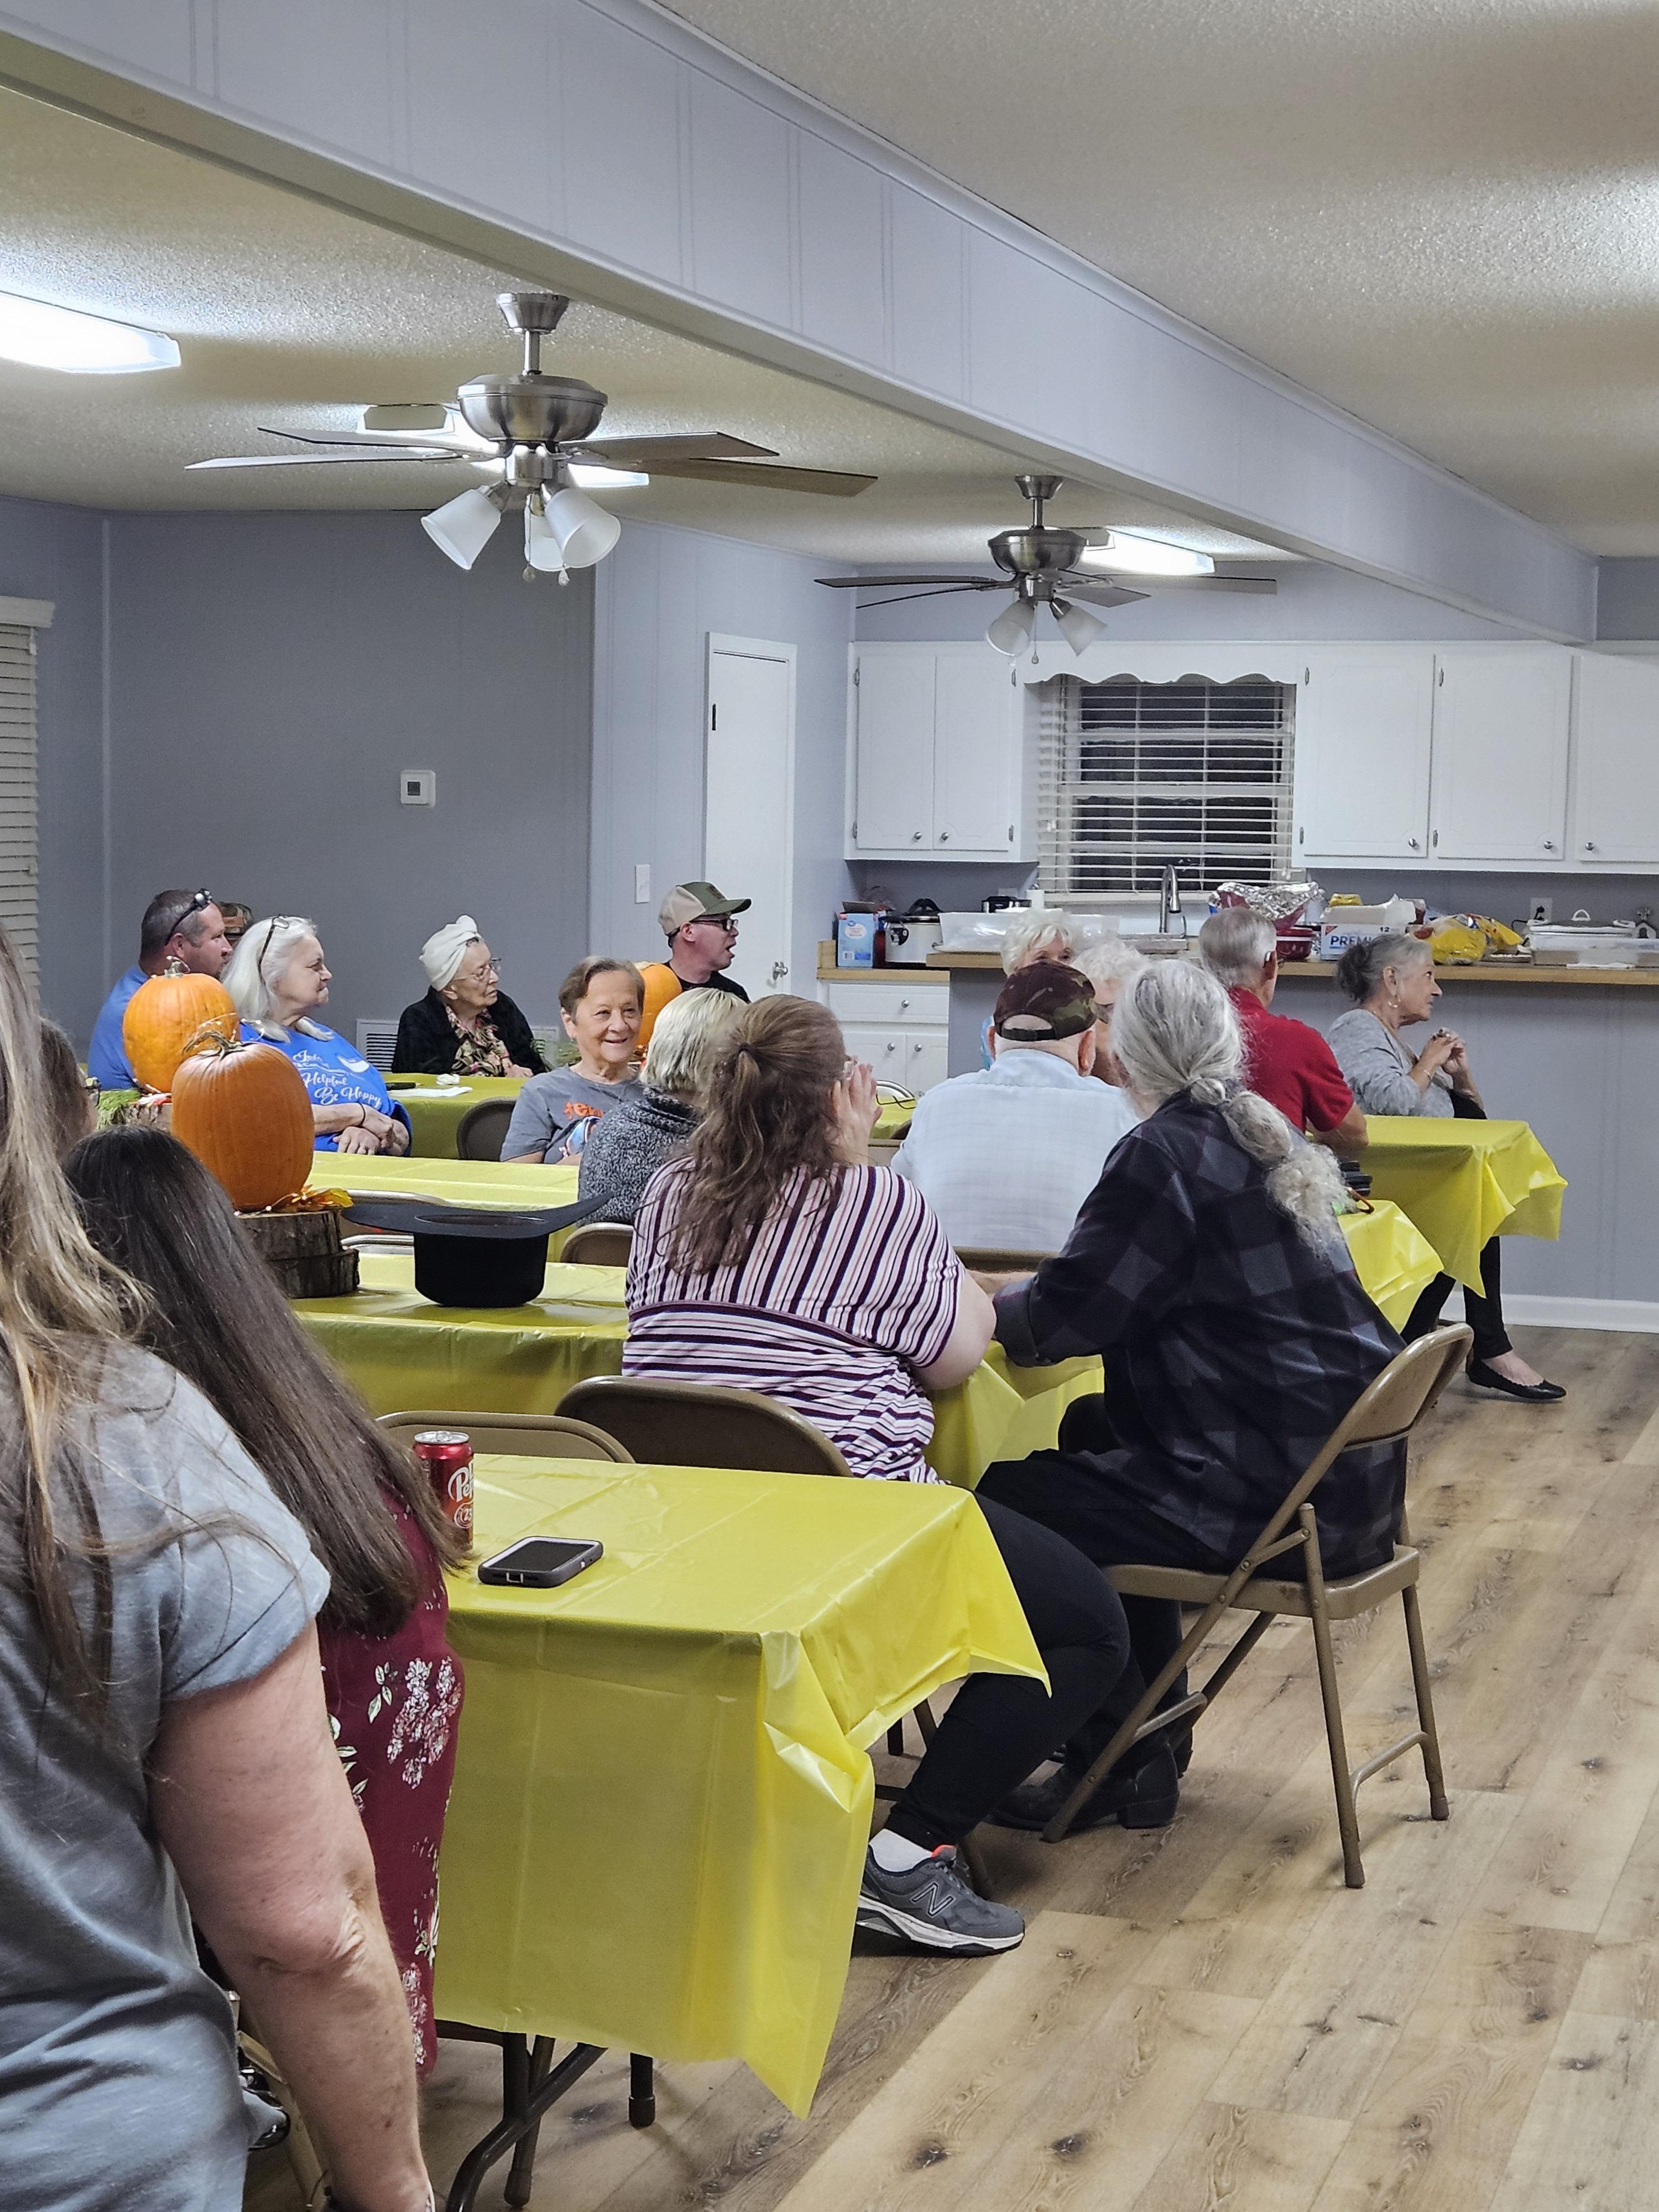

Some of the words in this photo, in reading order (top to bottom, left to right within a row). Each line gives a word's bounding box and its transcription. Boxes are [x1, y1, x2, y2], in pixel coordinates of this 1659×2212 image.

[300, 1071, 348, 1088] Helpful
[314, 1087, 339, 1105] Be
[341, 1086, 383, 1108] Happy
[911, 1881, 957, 1918] N
